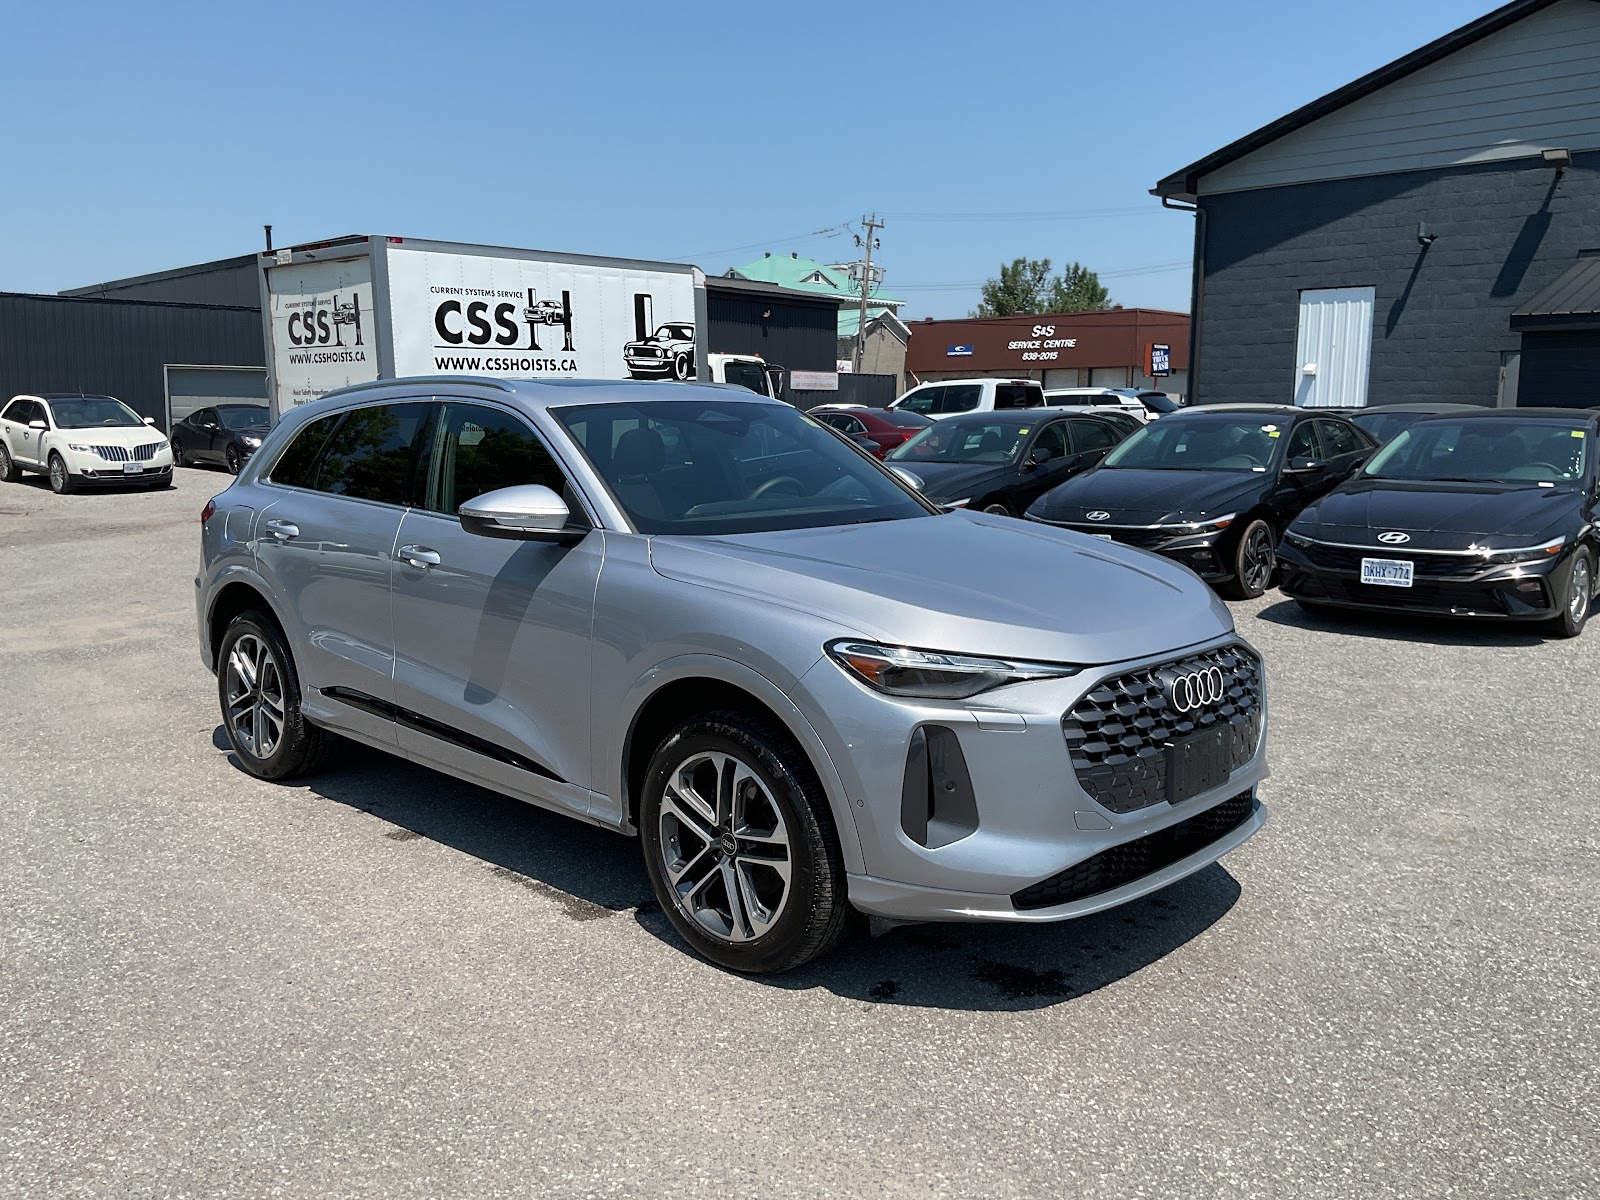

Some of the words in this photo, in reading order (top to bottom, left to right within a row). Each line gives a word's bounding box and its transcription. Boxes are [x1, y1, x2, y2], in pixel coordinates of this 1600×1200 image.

[430, 286, 463, 295] CURRENT
[465, 288, 495, 297] SYSTEMS
[497, 290, 524, 298] SERVICE
[1031, 325, 1056, 338] S&S
[1007, 340, 1042, 350] SERVICE
[1043, 339, 1077, 349] CENTRE
[289, 351, 366, 365] WWW.CSSHOISTS.CA
[1021, 351, 1059, 361] 838-2015
[434, 357, 578, 372] WWW.CSSHOISTS.CA
[1152, 362, 1169, 372] WASH
[1363, 565, 1387, 578] DKHX
[1392, 567, 1410, 580] 774
